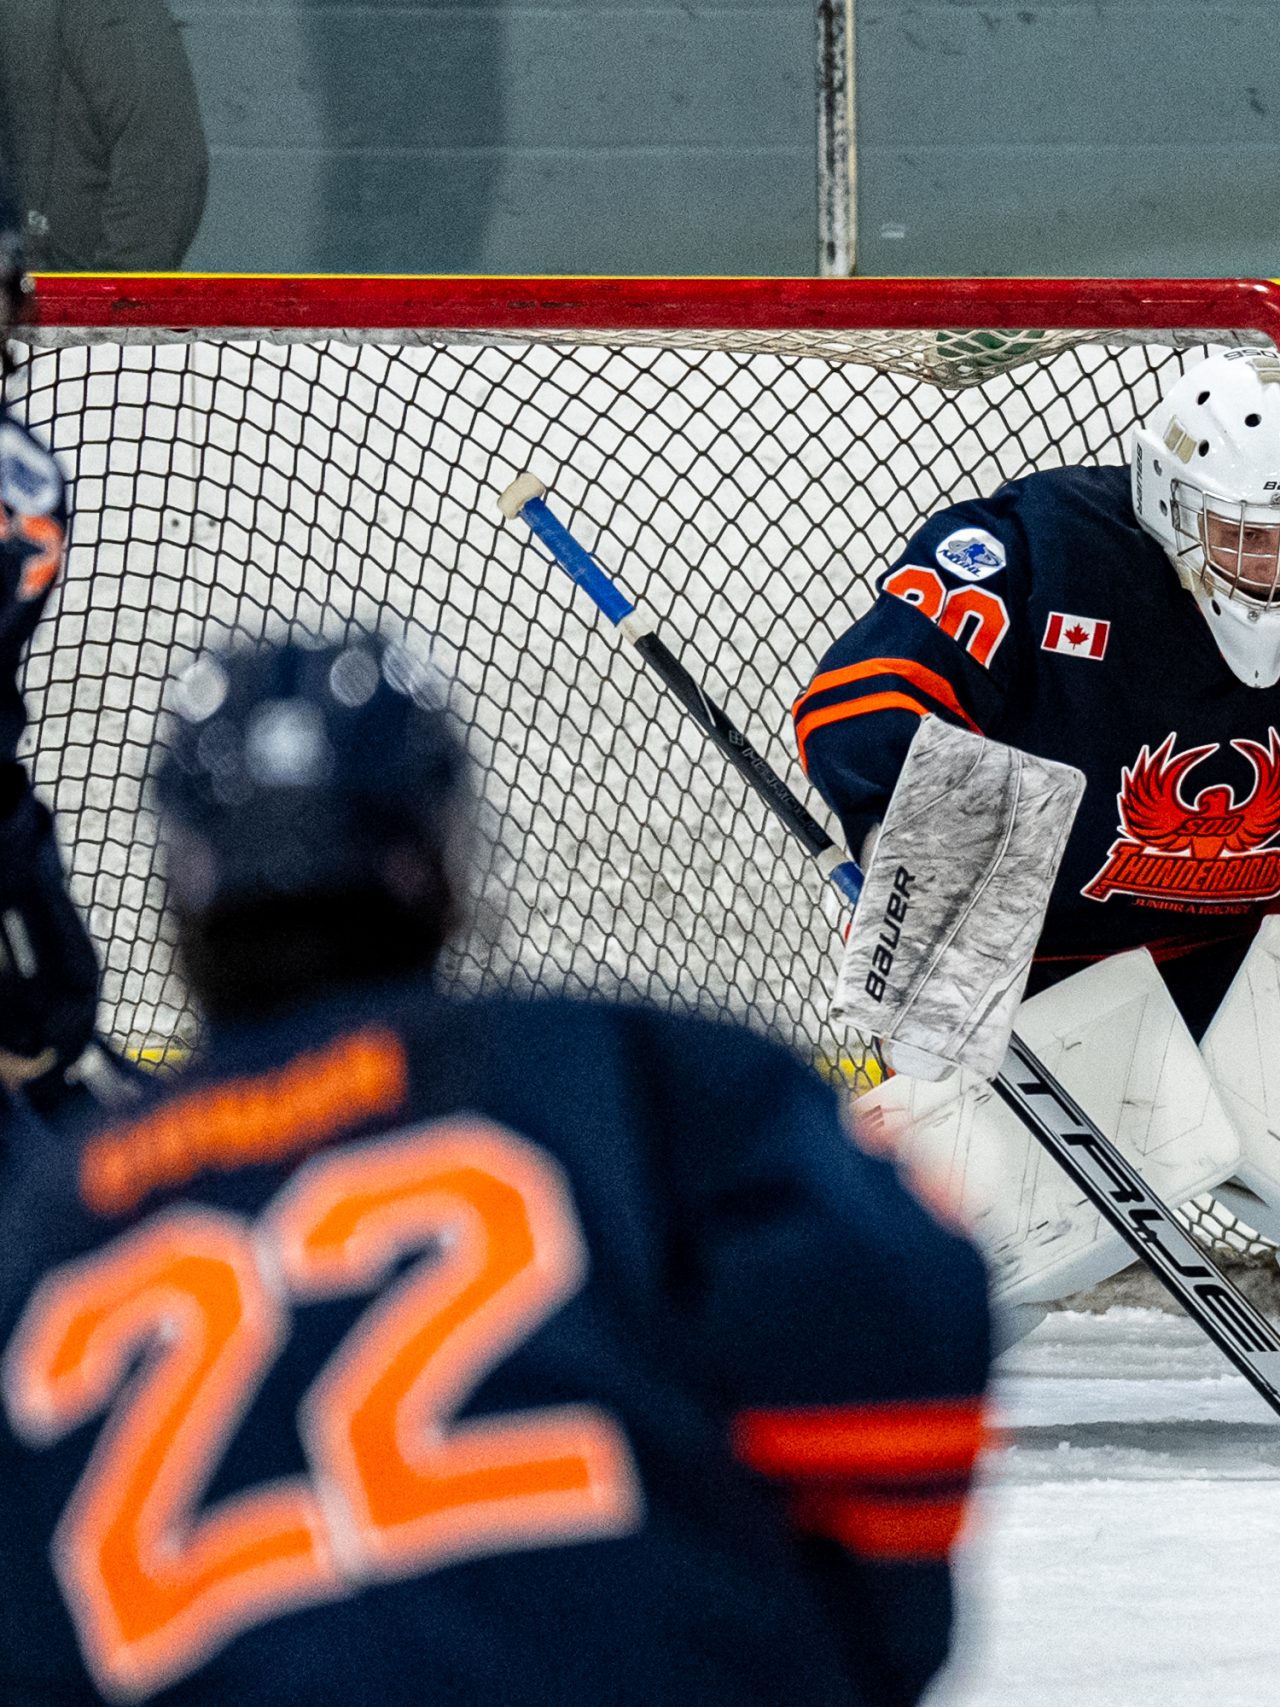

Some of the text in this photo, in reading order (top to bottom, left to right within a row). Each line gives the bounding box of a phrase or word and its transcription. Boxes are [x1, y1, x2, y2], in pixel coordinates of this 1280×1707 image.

[1223, 349, 1279, 361] 950
[1177, 816, 1244, 837] SOO
[864, 865, 916, 1003] BAUER
[1009, 1045, 1279, 1353] TRUE
[5, 1117, 643, 1701] 22
